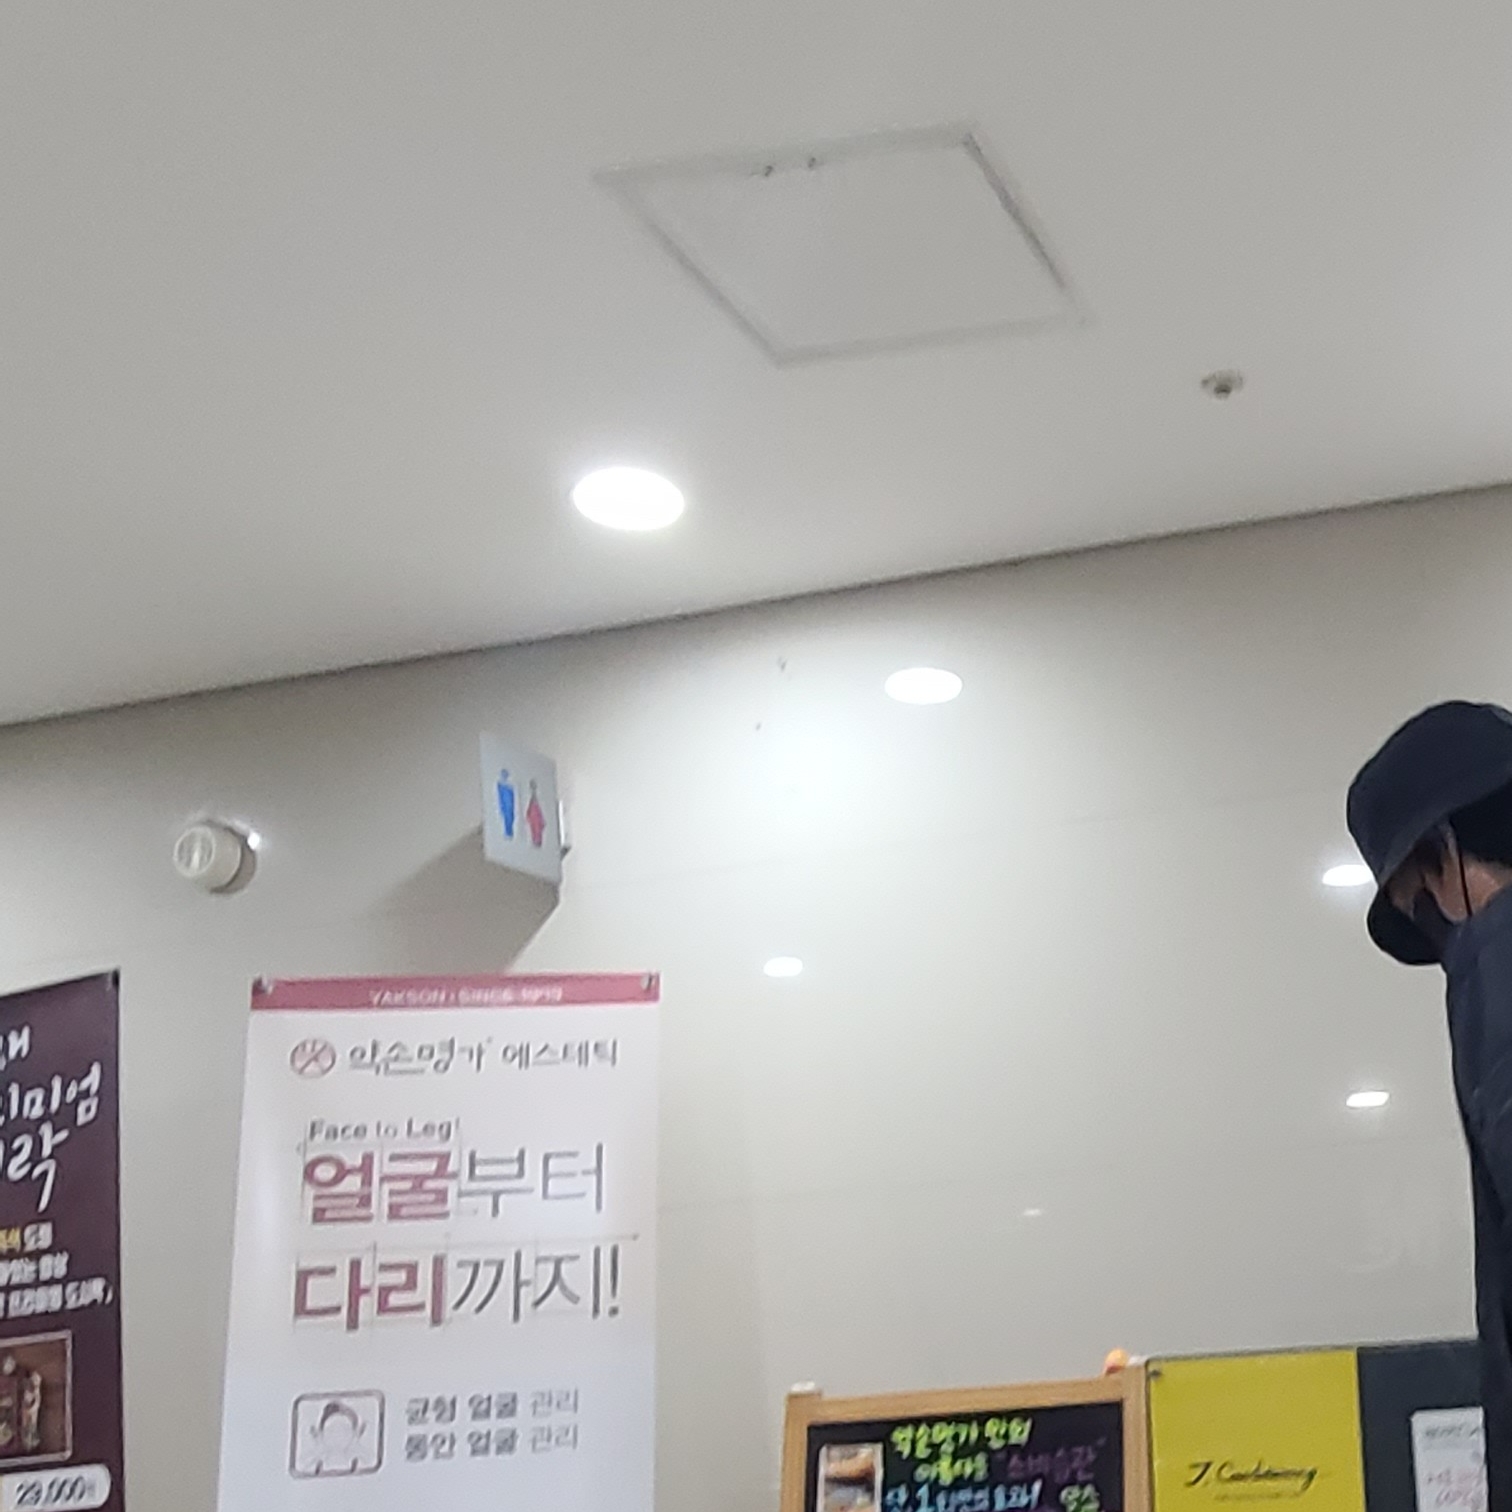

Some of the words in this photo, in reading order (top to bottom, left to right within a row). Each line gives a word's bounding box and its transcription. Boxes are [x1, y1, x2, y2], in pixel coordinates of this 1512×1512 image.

[348, 1036, 486, 1077] 약손명가
[502, 1038, 618, 1070] 에스테틱
[309, 1118, 367, 1142] Face
[376, 1120, 398, 1139] to
[303, 1142, 605, 1225] 얼굴부터
[293, 1243, 622, 1331] 다리까지!
[530, 1387, 579, 1418] 관리
[530, 1423, 579, 1453] 관리
